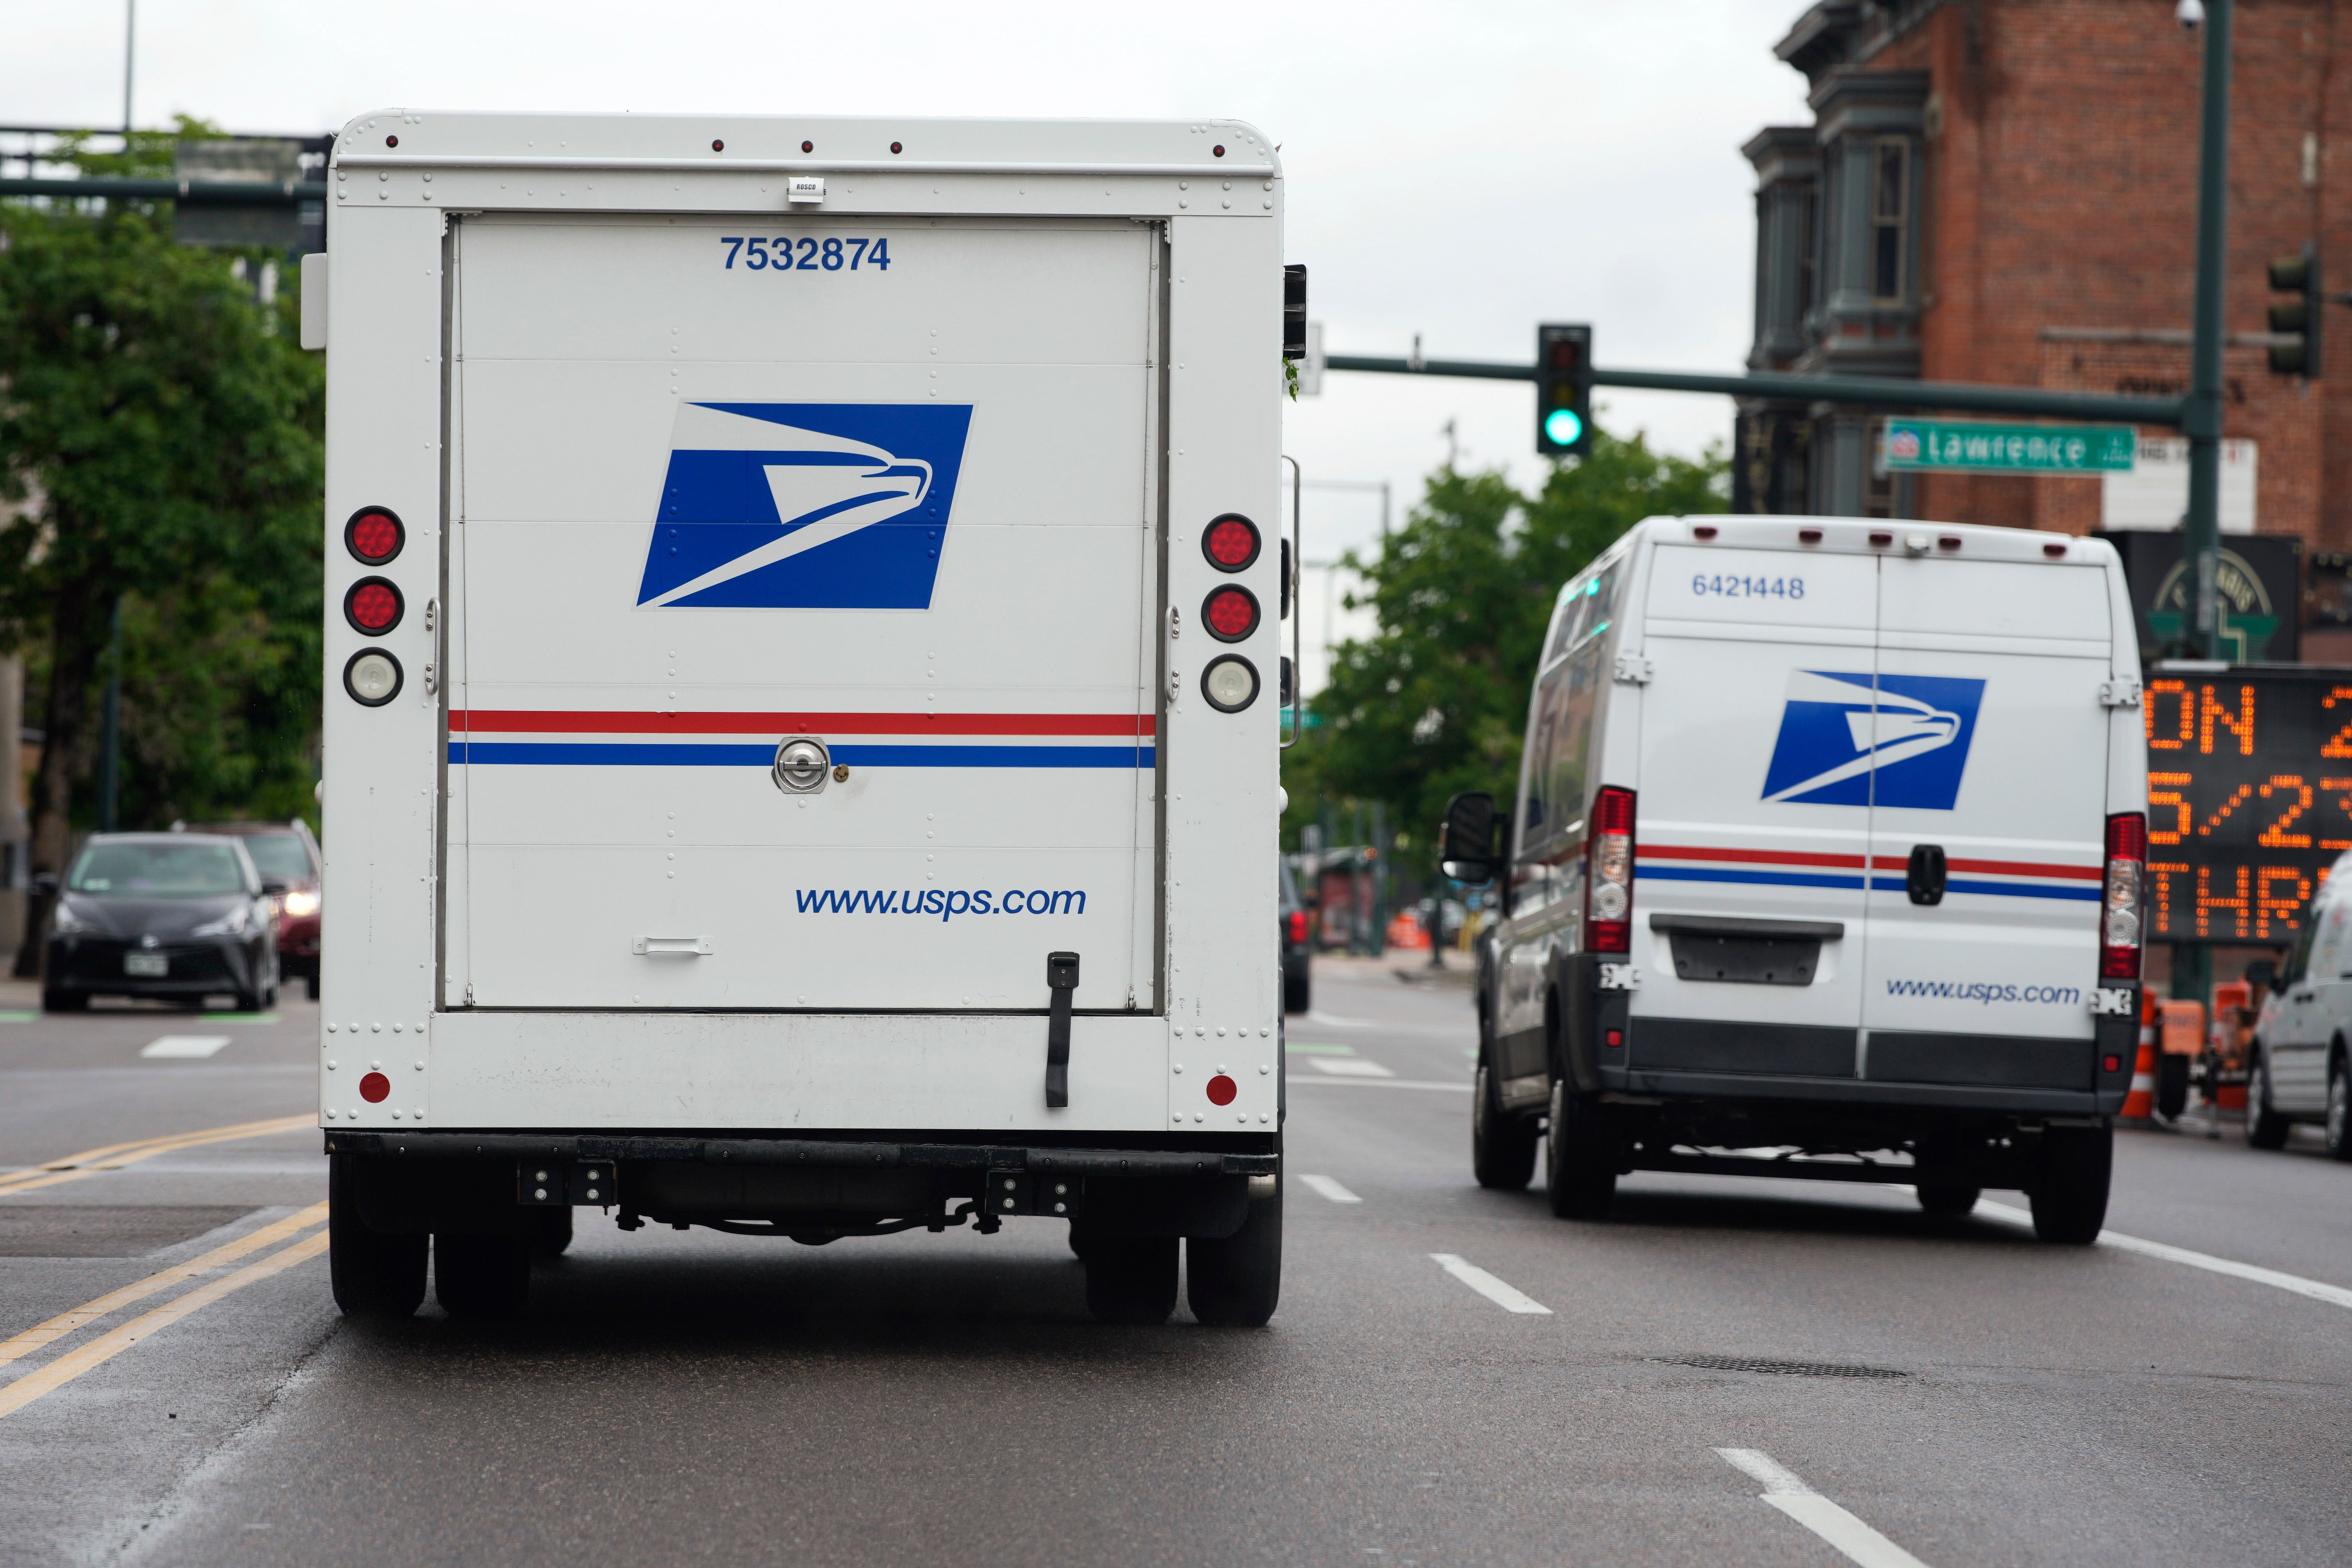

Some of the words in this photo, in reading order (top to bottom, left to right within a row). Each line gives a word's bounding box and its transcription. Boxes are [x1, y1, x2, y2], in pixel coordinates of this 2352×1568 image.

[721, 237, 891, 271] 7532874
[1928, 429, 2086, 467] Lawrence
[1692, 574, 1804, 599] 6421448
[2143, 679, 2255, 755] ON
[795, 889, 1086, 922] www.usps.com
[2147, 863, 2331, 938] THR
[1887, 980, 2081, 1005] www.usps.com
